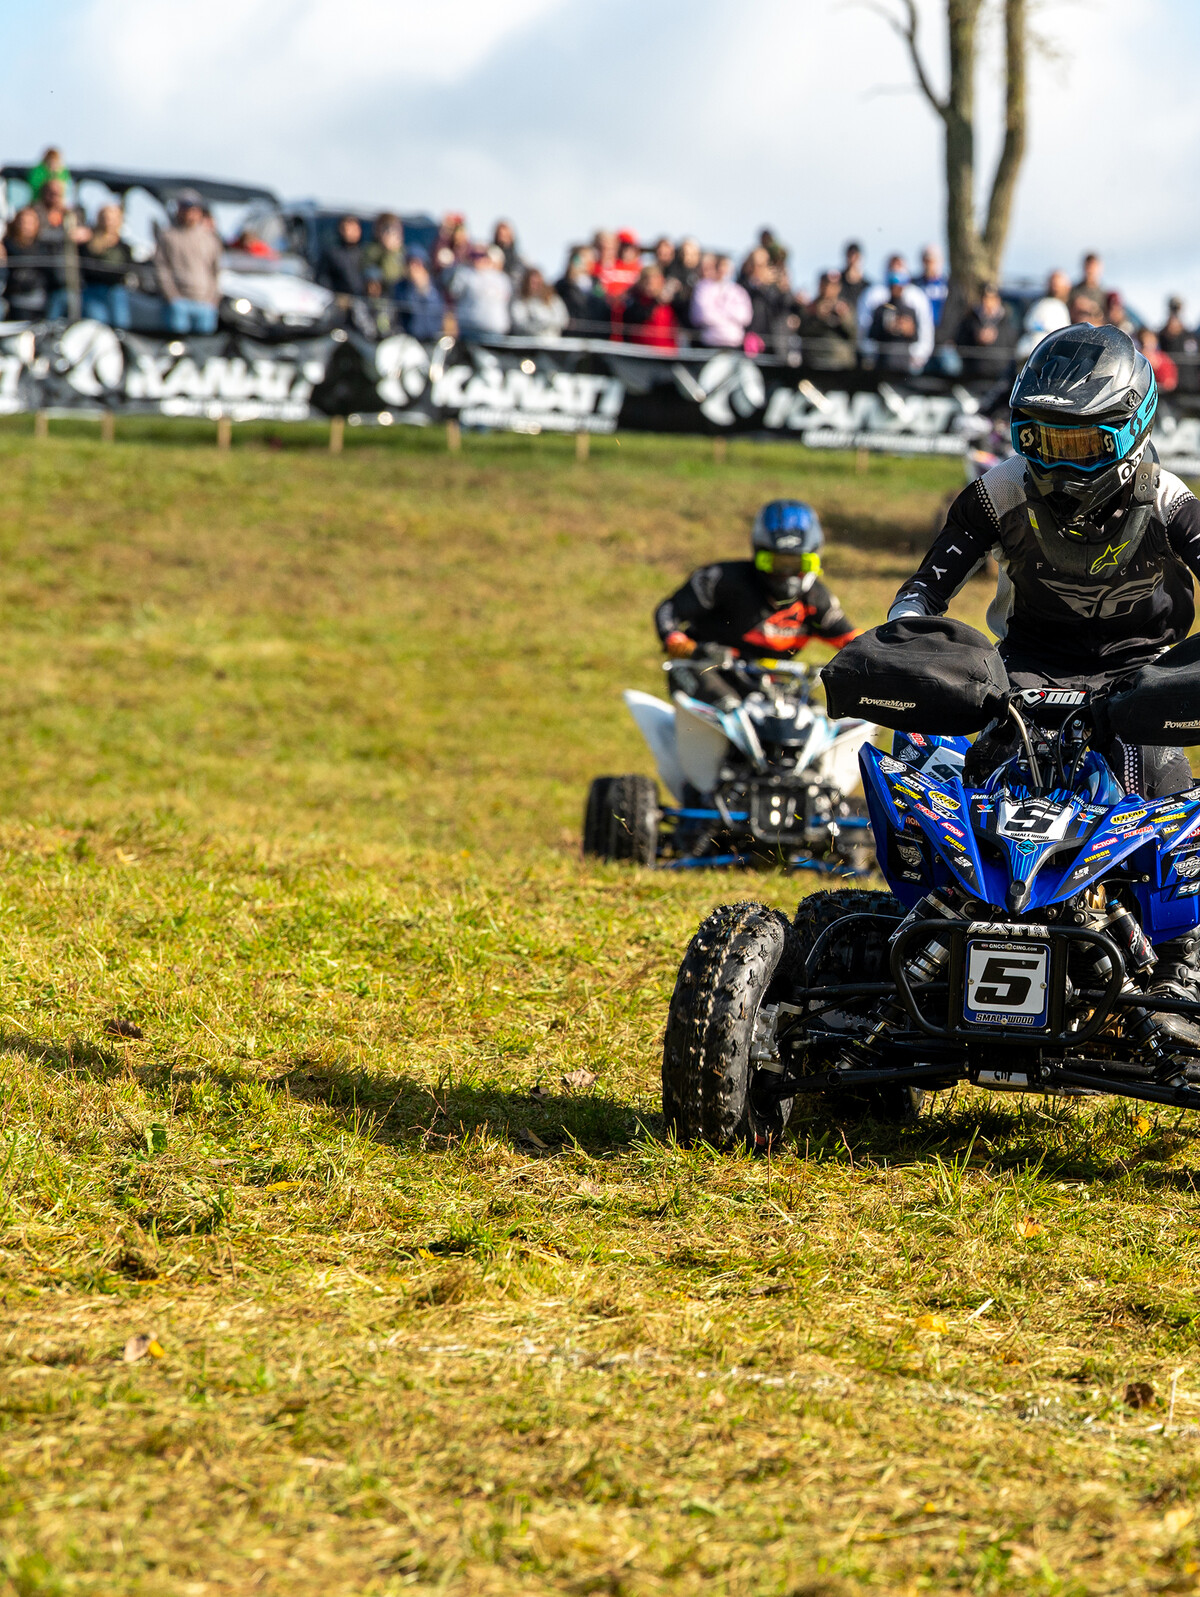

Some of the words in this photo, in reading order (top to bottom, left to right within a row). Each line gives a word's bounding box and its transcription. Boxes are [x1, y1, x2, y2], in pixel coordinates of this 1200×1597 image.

[1004, 804, 1061, 834] 5
[1123, 825, 1154, 839] KENDA
[902, 870, 922, 881] SSI
[1178, 881, 1200, 894] SSI
[967, 922, 1050, 938] RATH
[974, 957, 1040, 1006] 5
